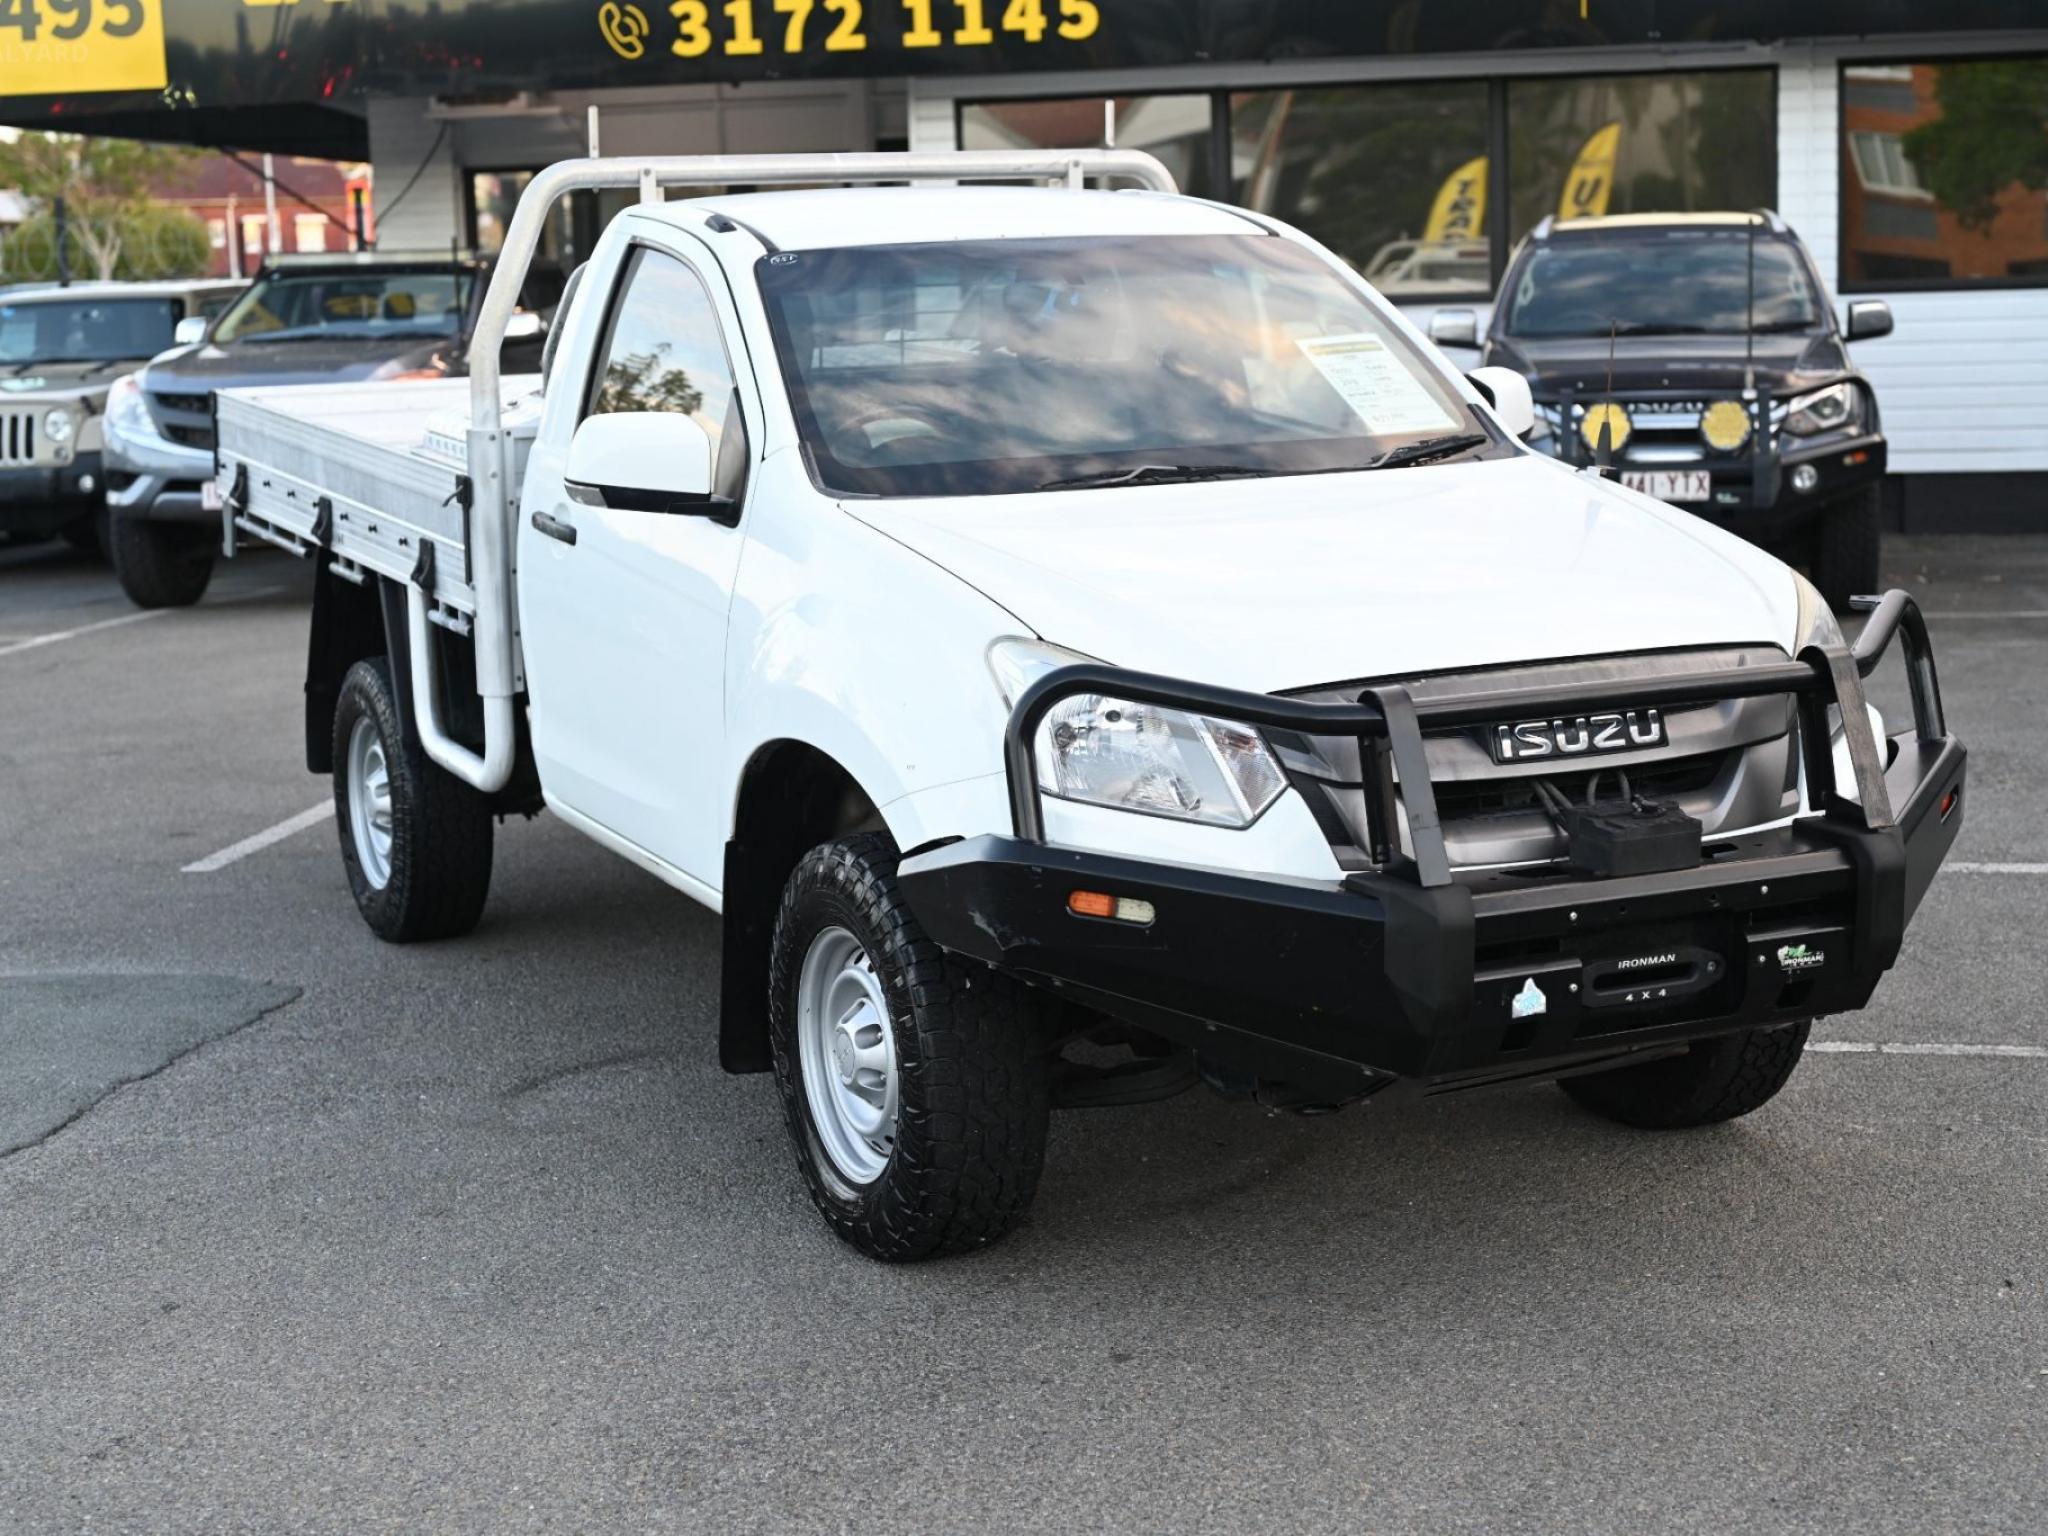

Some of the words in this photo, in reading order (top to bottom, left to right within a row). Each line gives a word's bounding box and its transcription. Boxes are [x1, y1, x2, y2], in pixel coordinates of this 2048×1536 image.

[671, 0, 867, 57] 3172
[902, 0, 1100, 47] 1145
[1498, 709, 1661, 758] ISUZU
[1617, 953, 1676, 970] IRONMAN
